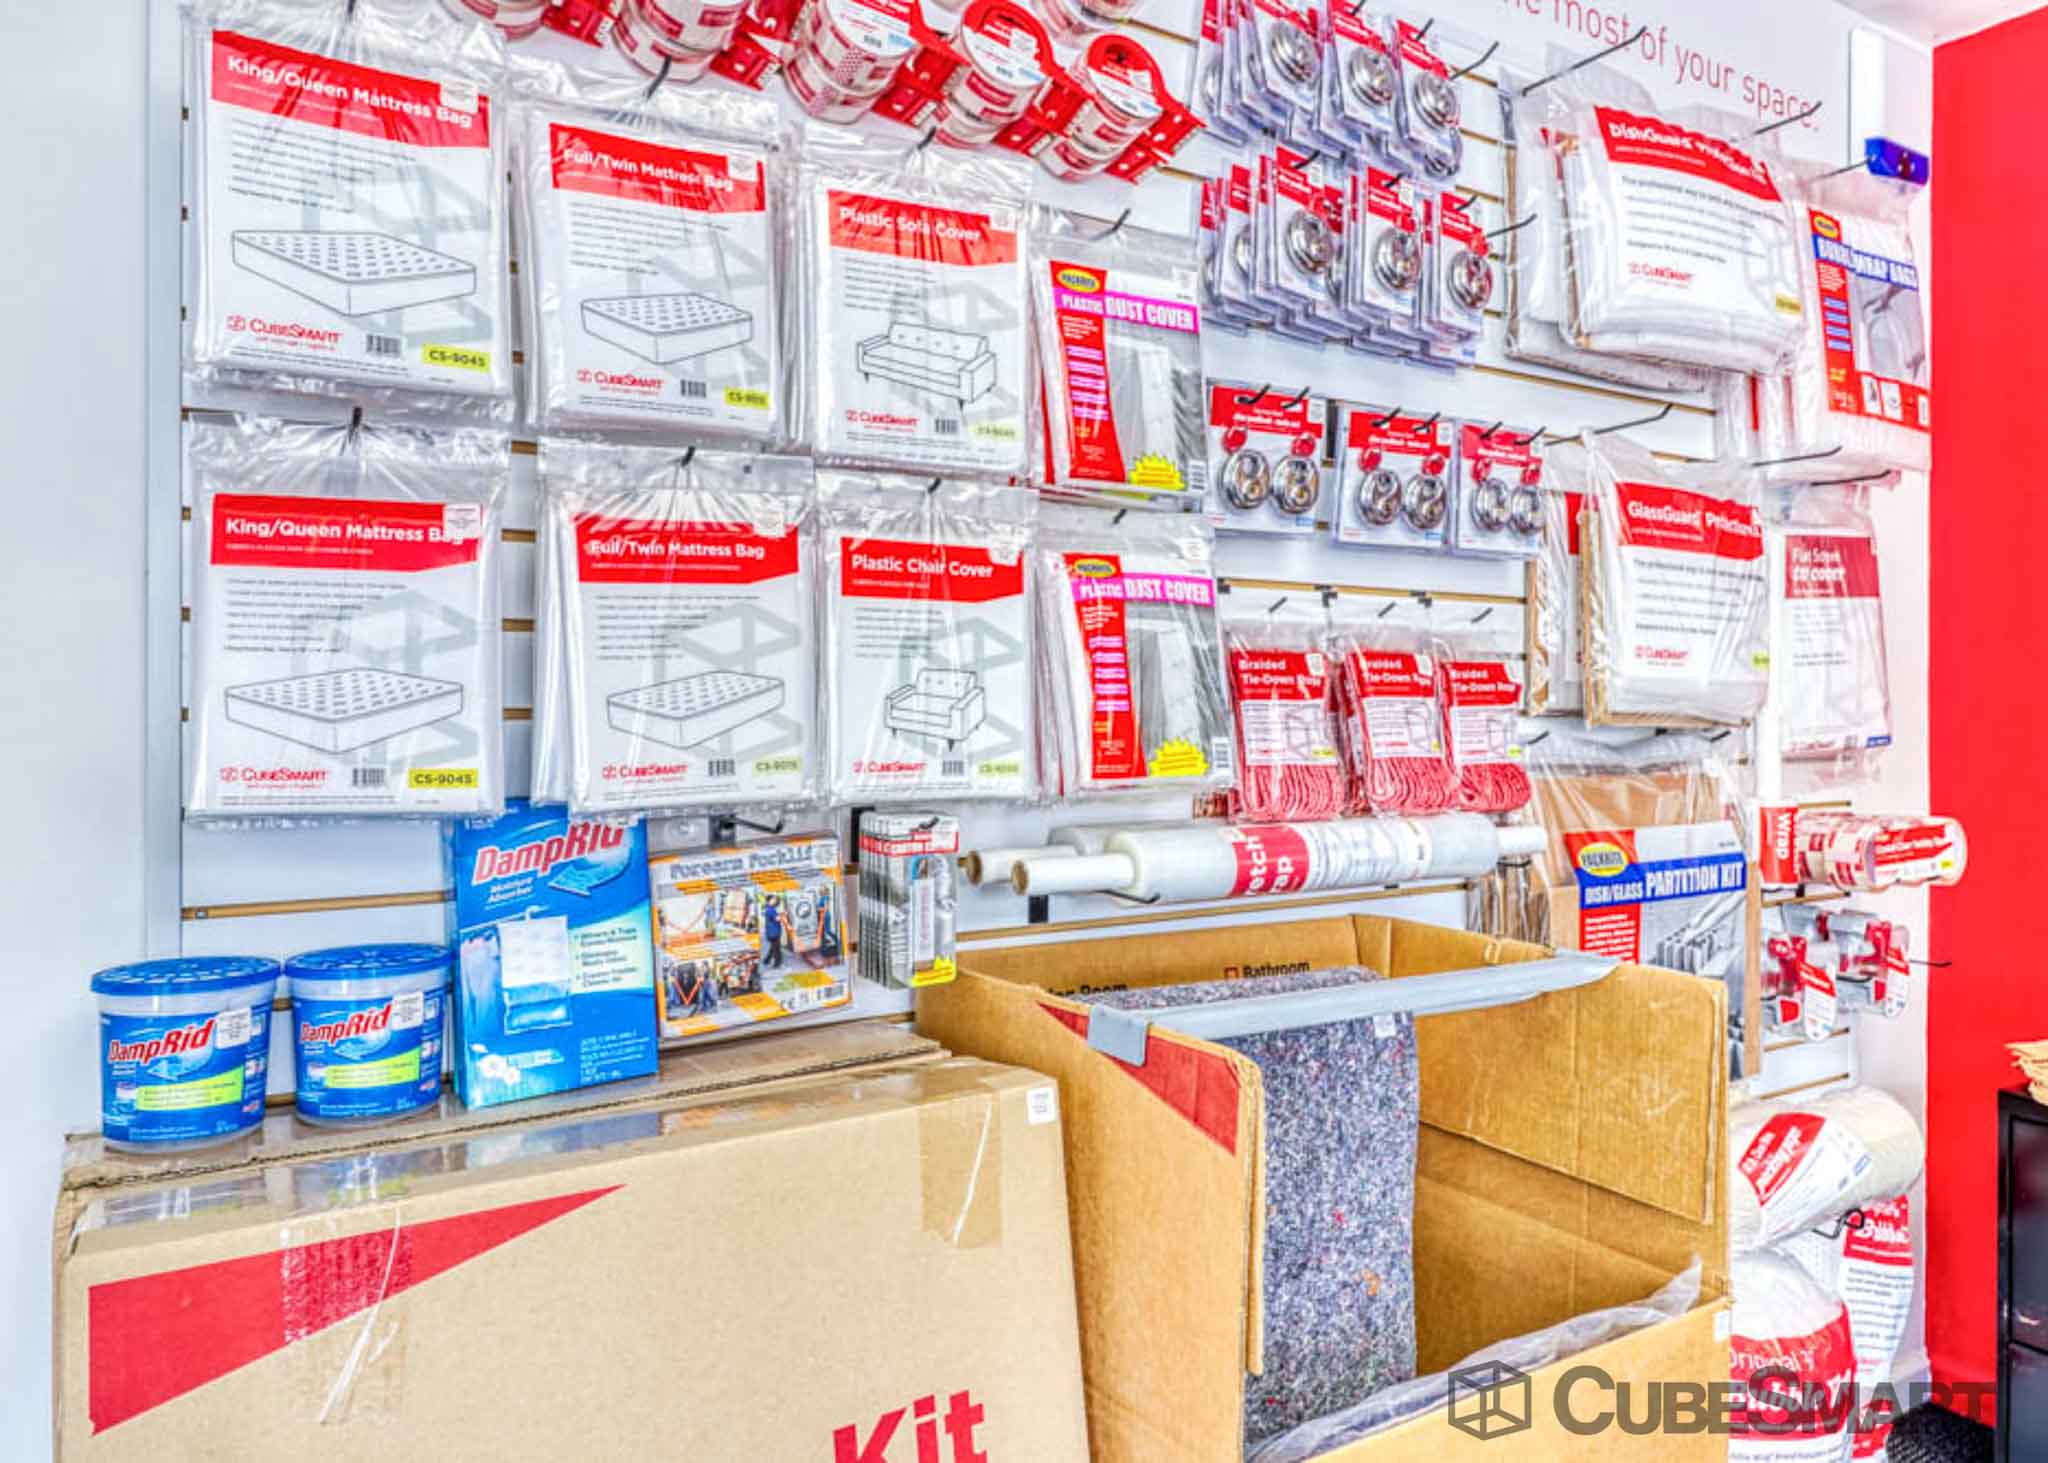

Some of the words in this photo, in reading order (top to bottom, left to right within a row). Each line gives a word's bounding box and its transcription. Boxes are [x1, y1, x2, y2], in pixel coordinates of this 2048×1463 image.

[1554, 0, 1630, 51] most
[1641, 26, 1667, 65] of
[1674, 44, 1736, 92] your
[228, 56, 349, 101] King/Queen
[353, 86, 433, 120] Mattress
[436, 106, 474, 130] Bag
[563, 148, 639, 177] Full/Twin
[641, 163, 701, 185] Mattress
[704, 173, 735, 192] Bag
[839, 206, 892, 229] Plastic
[897, 214, 930, 236] Sofa
[935, 222, 982, 241] Cover
[1106, 297, 1143, 322] DUST
[1146, 304, 1194, 330] COVER
[1628, 501, 1700, 527] GlassGuard
[225, 518, 341, 541] King/Queen
[346, 524, 423, 541] Mattress
[429, 527, 465, 545] Bag
[589, 538, 666, 557] Full/Twin
[668, 541, 732, 557] Mattress
[735, 544, 765, 560] Bag
[851, 554, 902, 572] Plastic
[907, 558, 947, 574] Chair
[949, 561, 993, 577] Cover
[1125, 580, 1162, 600] DUST
[1164, 582, 1210, 602] COVER
[1239, 658, 1286, 671] Braided
[1362, 658, 1402, 670] Braided
[1450, 668, 1488, 680] Braided
[1242, 674, 1295, 686] Tie-Down
[1364, 671, 1410, 683] Tie-Down
[1452, 681, 1496, 692] Tie-Down
[413, 773, 473, 785] CS-9045
[1646, 864, 1718, 898] PARTITION
[1720, 861, 1743, 888] KIT
[1243, 960, 1311, 979] Bathroom
[301, 1003, 392, 1046] DampRid
[108, 1019, 215, 1064] DampRid
[833, 1389, 988, 1463] Kit
